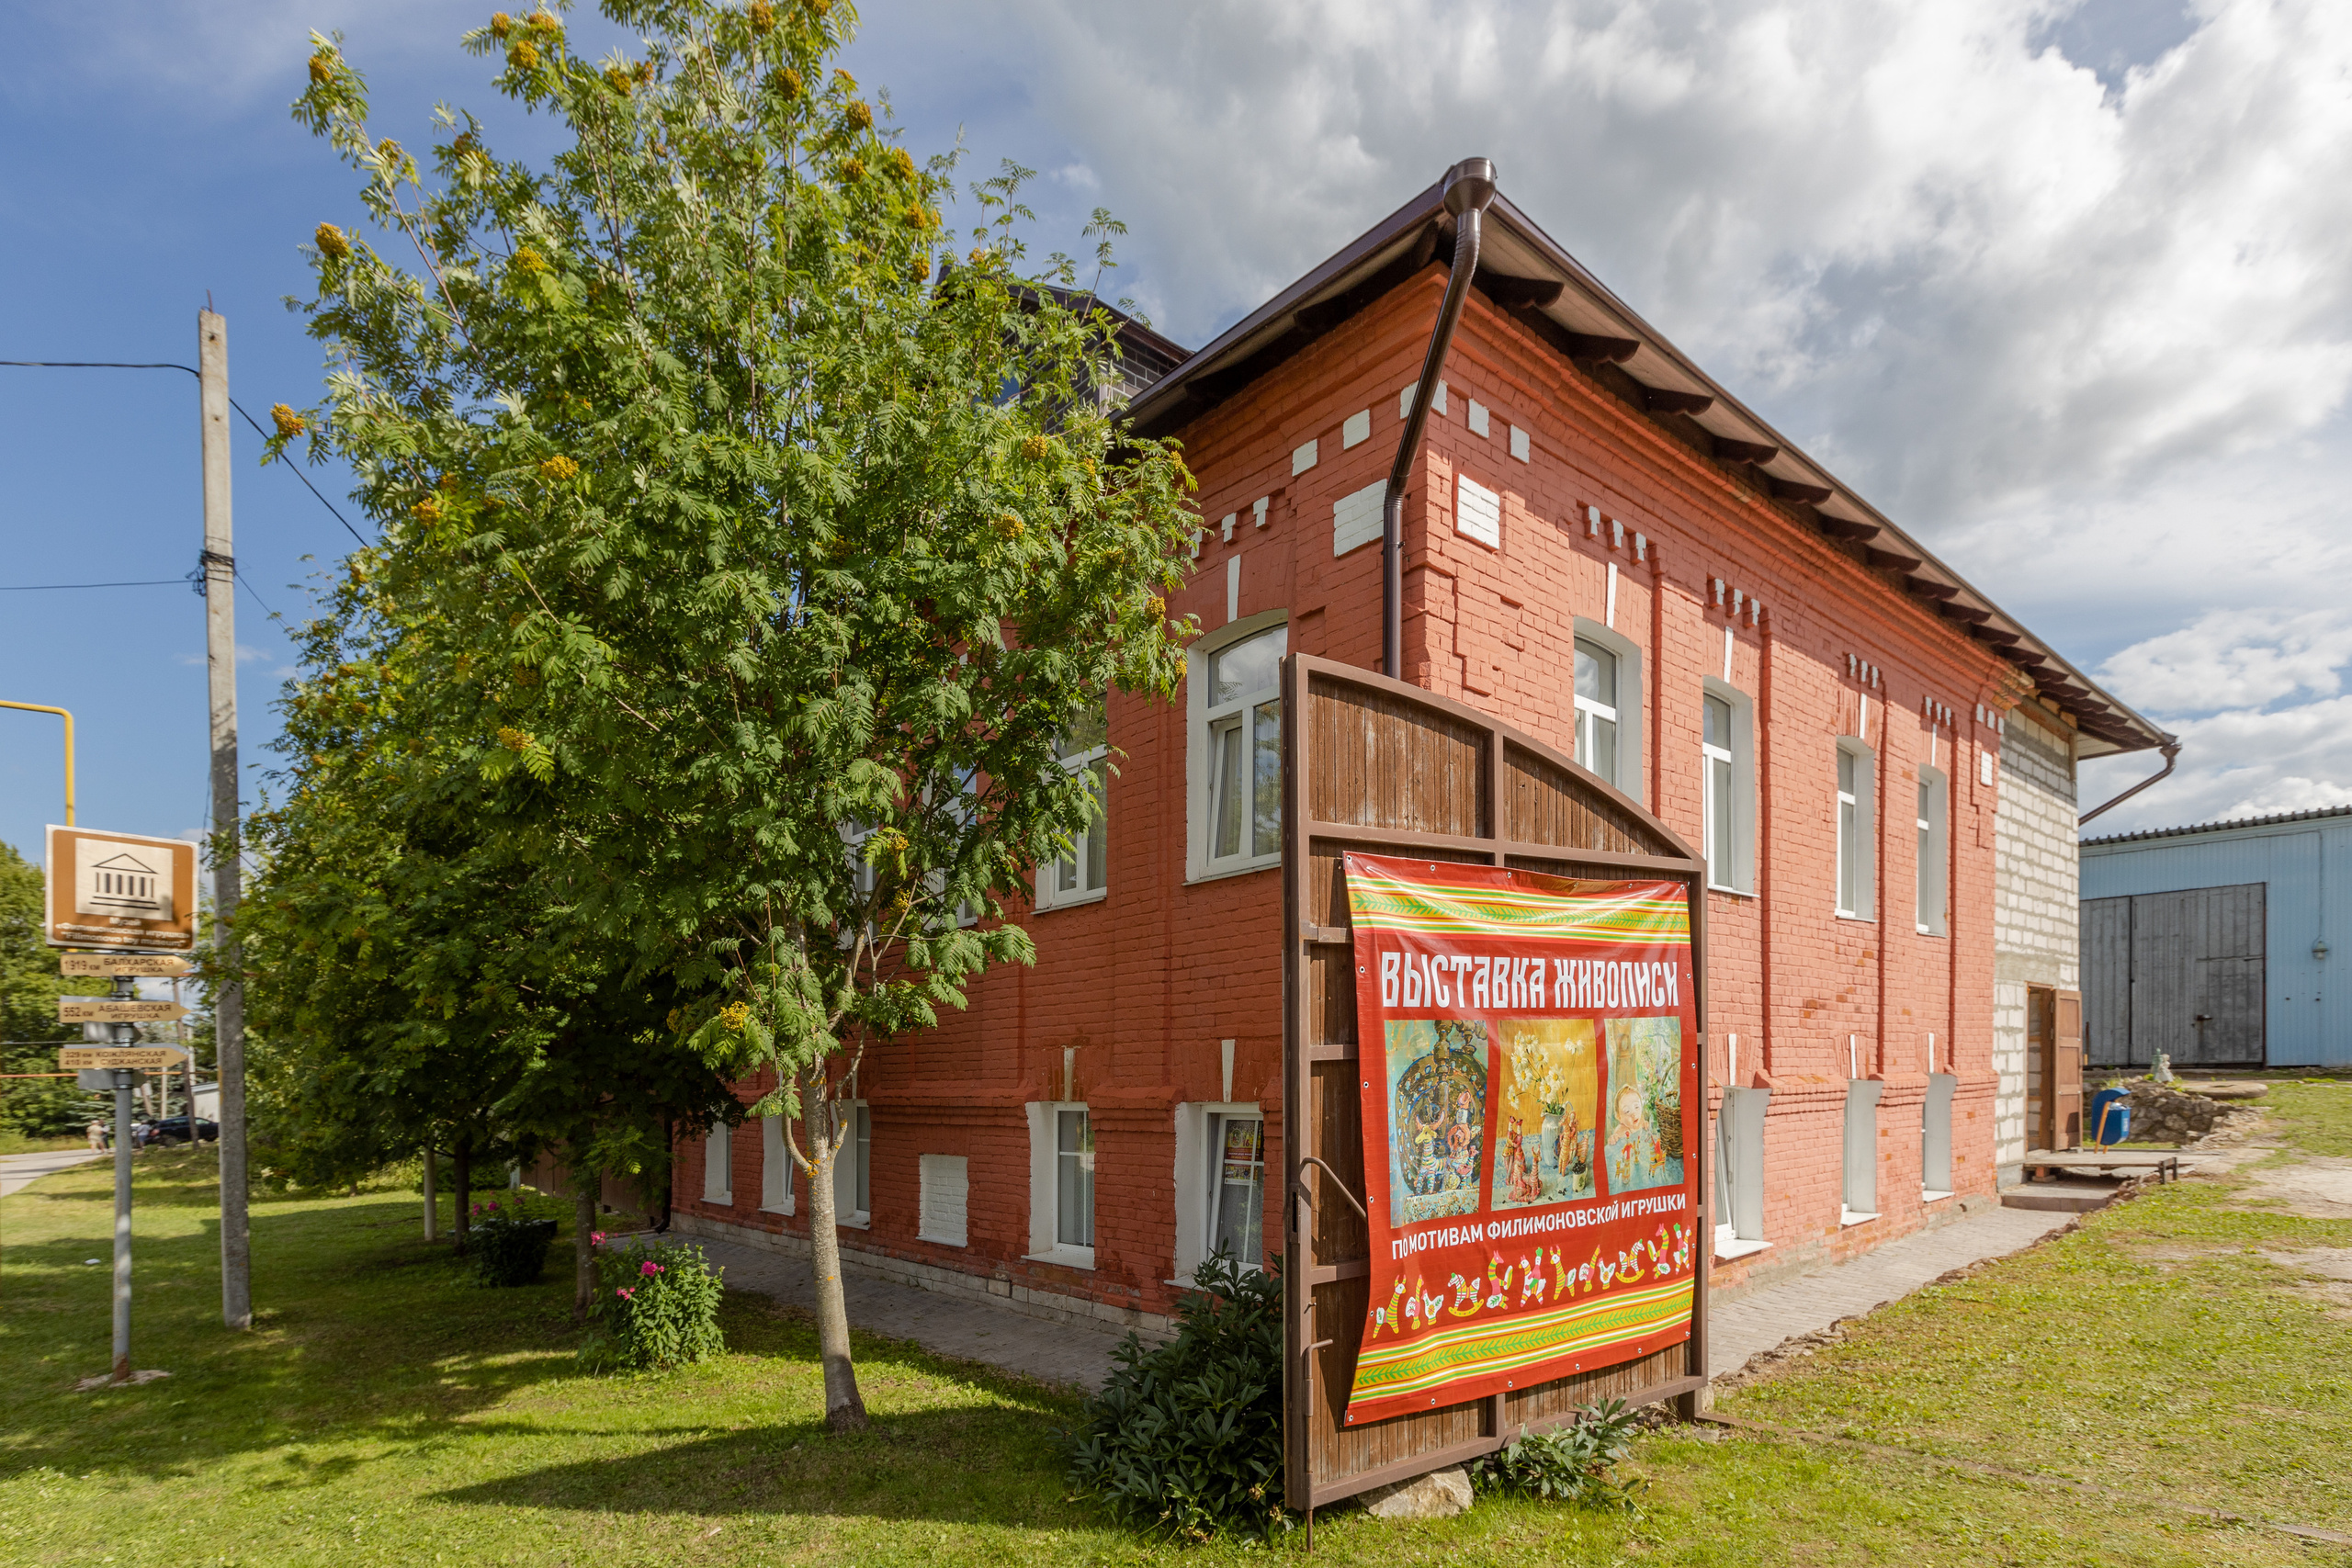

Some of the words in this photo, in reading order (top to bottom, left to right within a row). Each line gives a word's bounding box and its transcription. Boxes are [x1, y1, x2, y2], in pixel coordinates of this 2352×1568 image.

[109, 917, 141, 926] Музей
[123, 936, 139, 945] toy
[64, 960, 88, 971] 1919
[103, 957, 175, 965] БАЛХАРСКАЯ
[1382, 952, 1545, 1009] ВЫСТАВКА
[1555, 958, 1679, 1009] ЖИВОПИСИ
[63, 1007, 81, 1017] 552
[98, 1004, 172, 1012] АБАШЕВСКАЯ
[96, 1050, 167, 1058] КОЖЛЯНСКАЯ
[1391, 1239, 1408, 1260] ПО
[1409, 1223, 1484, 1254] МОТИВАМ
[1487, 1200, 1620, 1241] ФИЛИМОНОВСКОЙ
[1621, 1192, 1687, 1221] ИГРУШКИ
